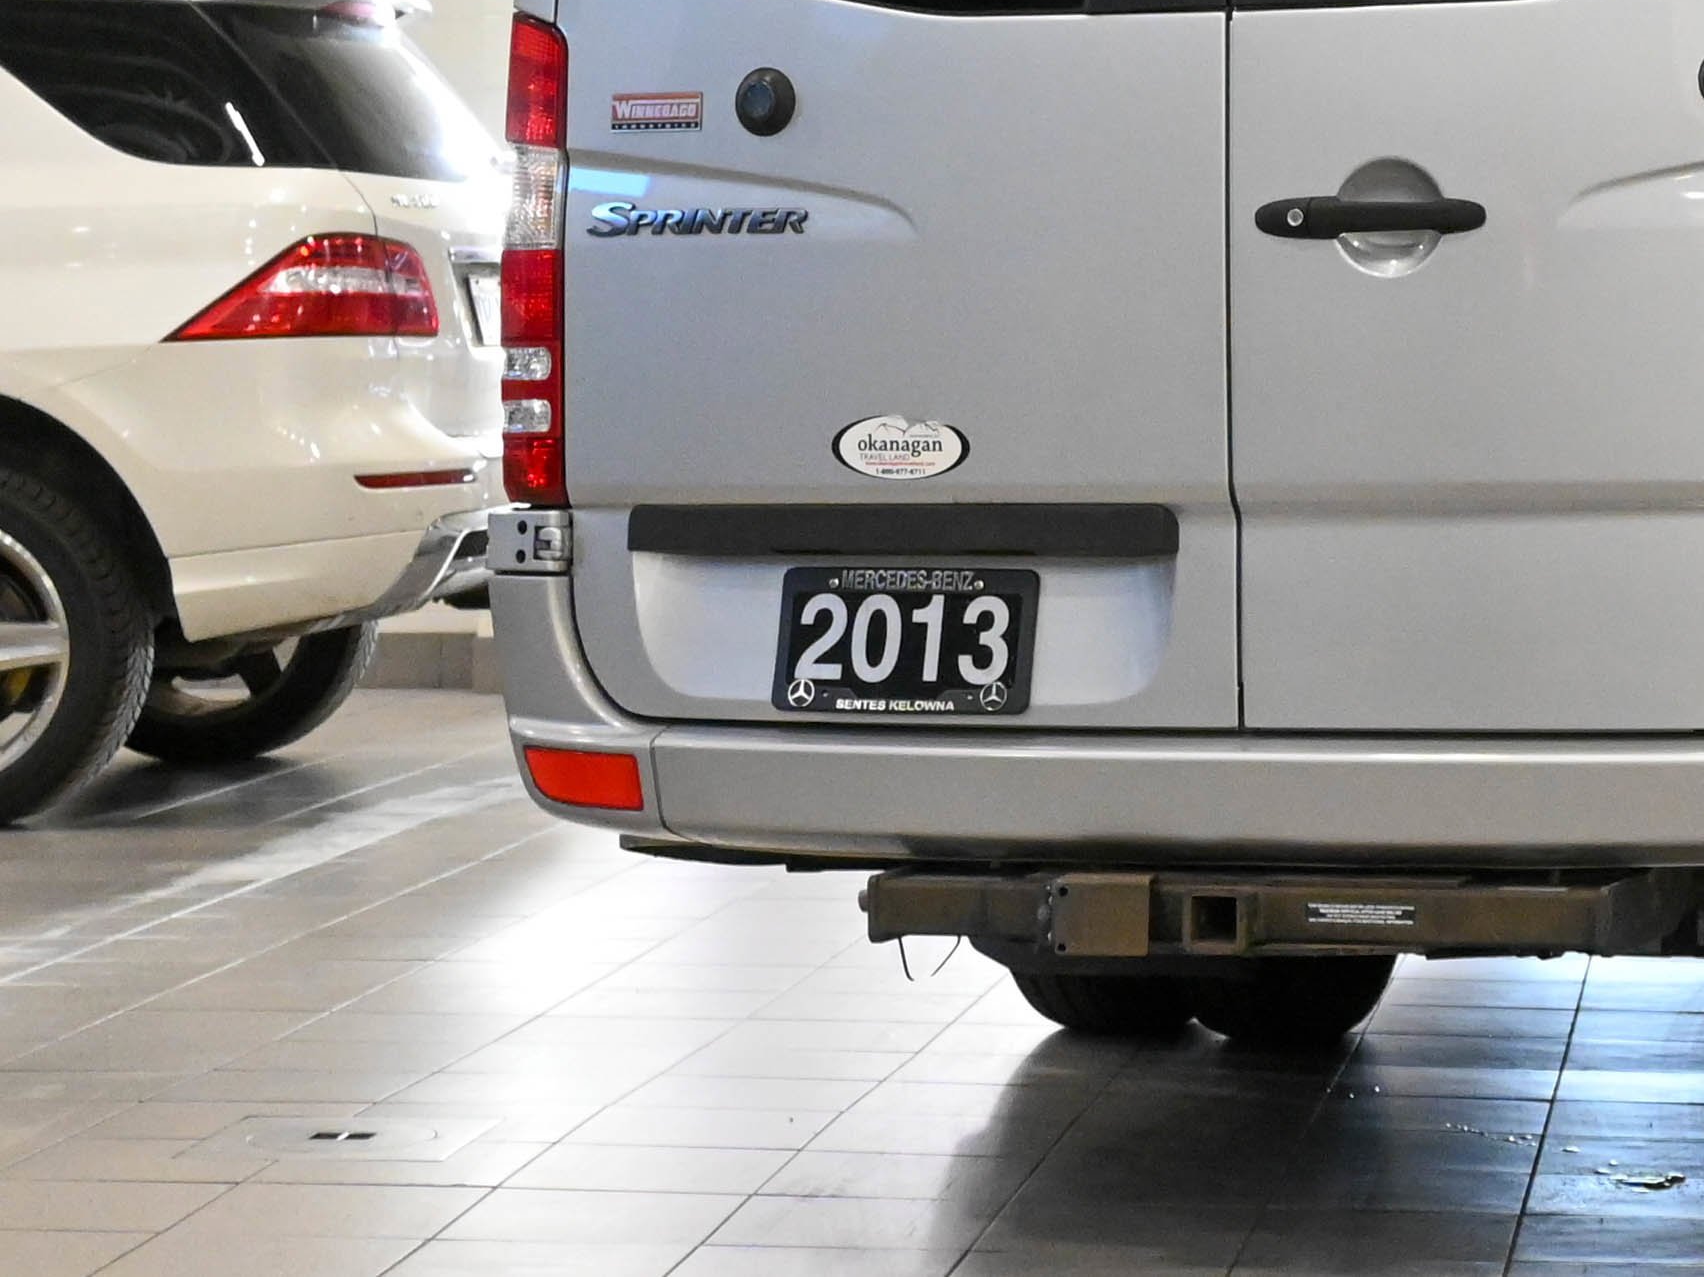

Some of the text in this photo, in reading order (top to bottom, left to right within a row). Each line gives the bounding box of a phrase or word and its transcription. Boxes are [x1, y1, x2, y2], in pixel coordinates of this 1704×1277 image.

[586, 201, 809, 237] SPRINTER
[857, 433, 943, 457] okanagan
[841, 570, 974, 591] MERCEDES-BENZ
[794, 593, 1010, 685] 2013
[835, 698, 955, 712] SENTES KELOWNA
